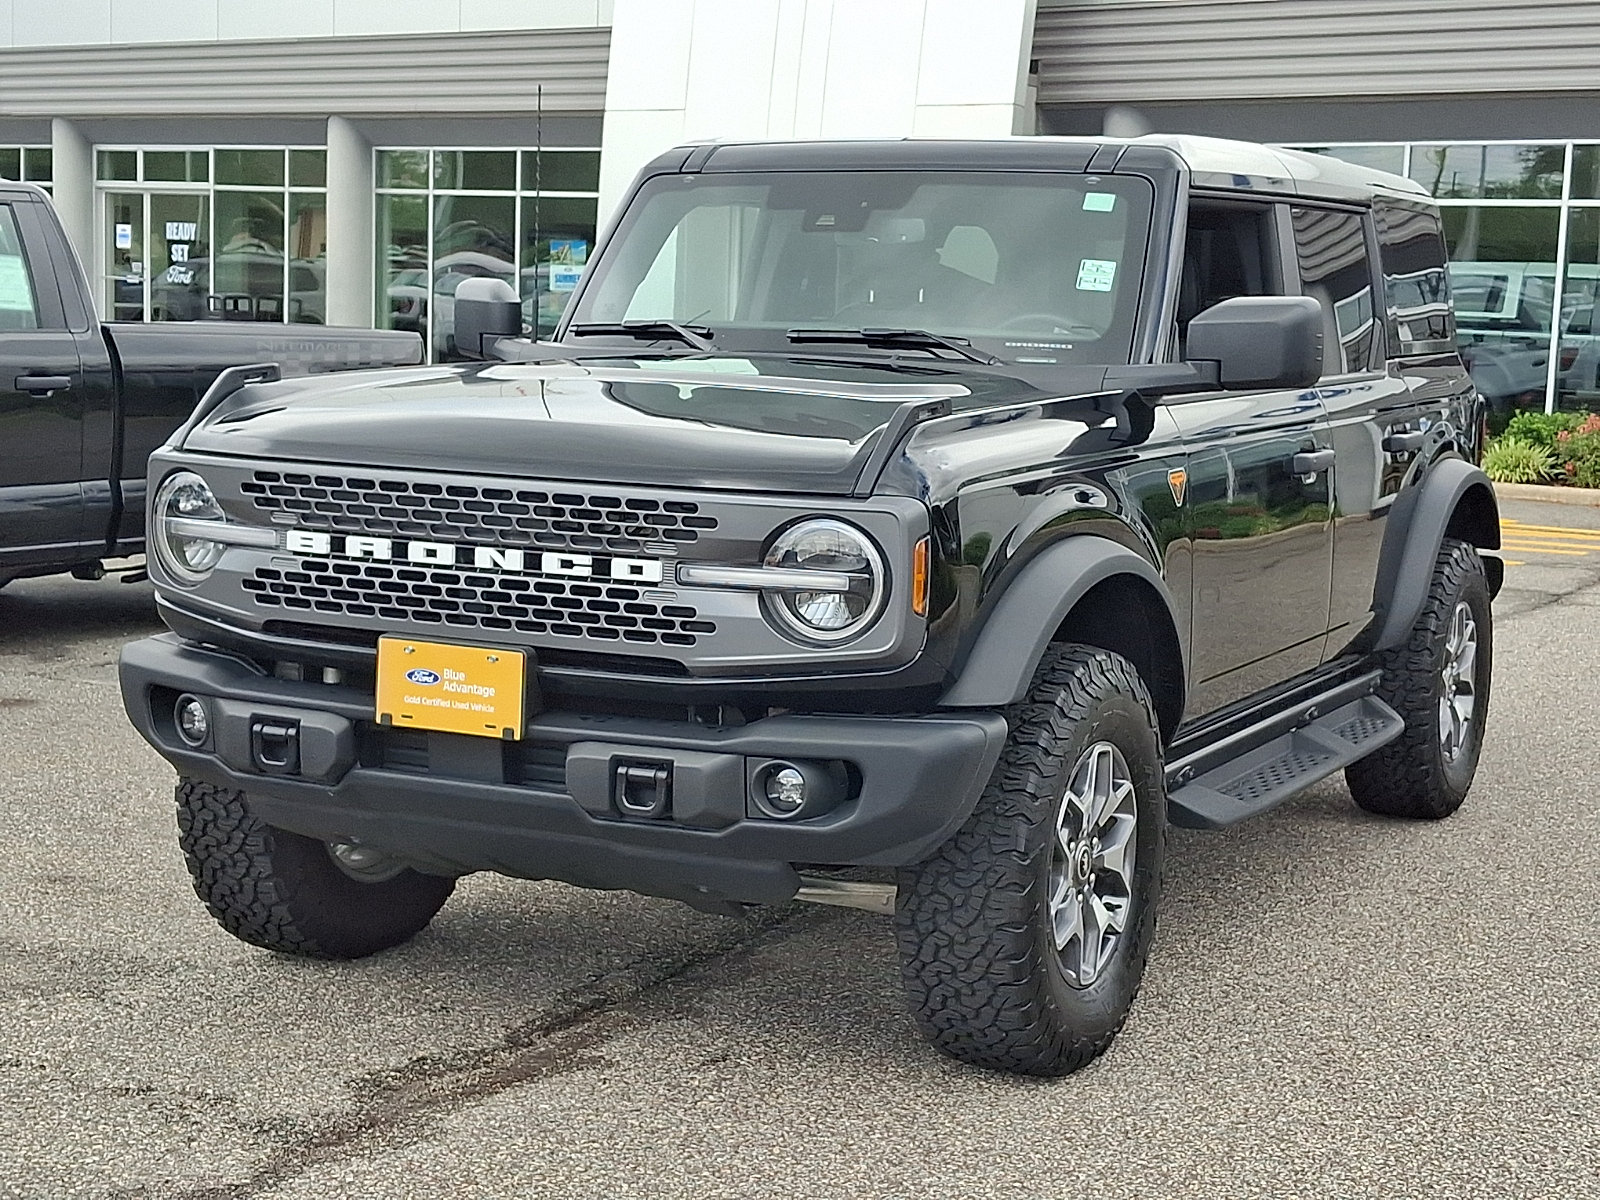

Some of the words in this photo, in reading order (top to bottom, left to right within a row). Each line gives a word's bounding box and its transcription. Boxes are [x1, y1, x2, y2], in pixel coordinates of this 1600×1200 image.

[166, 221, 197, 241] READY
[170, 243, 190, 263] SET
[166, 265, 194, 284] Ford
[286, 529, 663, 583] BRONCO
[410, 669, 436, 684] Ford
[443, 668, 466, 682] Blue
[443, 681, 496, 698] Advantage
[404, 695, 421, 704] Gold
[422, 696, 451, 709] Certified
[451, 702, 470, 711] Used
[471, 703, 495, 713] Vehicle
